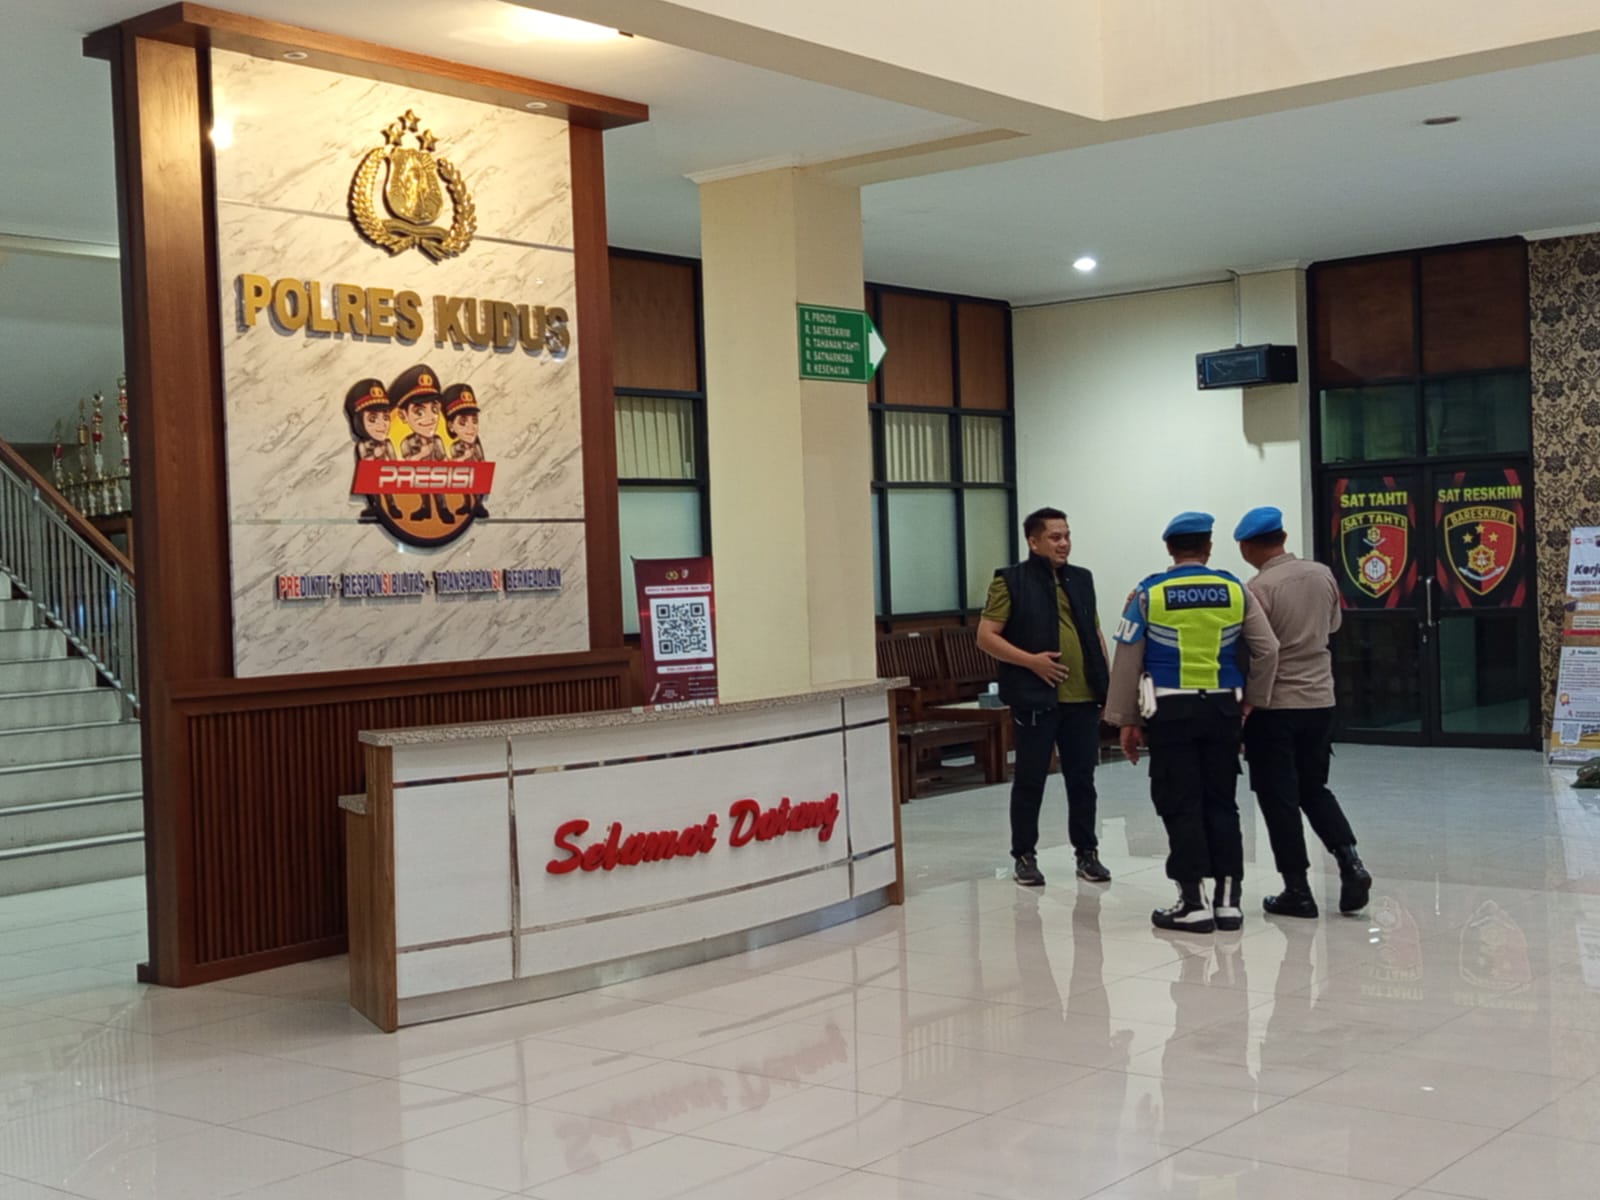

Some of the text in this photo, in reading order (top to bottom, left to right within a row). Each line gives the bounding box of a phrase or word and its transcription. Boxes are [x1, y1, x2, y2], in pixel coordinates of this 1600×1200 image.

[236, 273, 570, 358] POLRES KUDUS
[812, 312, 837, 324] PROVOS
[378, 465, 475, 489] PRESISI
[1340, 491, 1408, 508] SAT TAHTI
[1438, 485, 1523, 502] SAT RESKRIM
[1344, 514, 1406, 529] SAT TAHTI
[1450, 508, 1511, 525] BARESKRIM
[1574, 563, 1600, 578] Kerj
[1167, 588, 1228, 603] PROVOS
[546, 792, 840, 874] Selamat Datang
